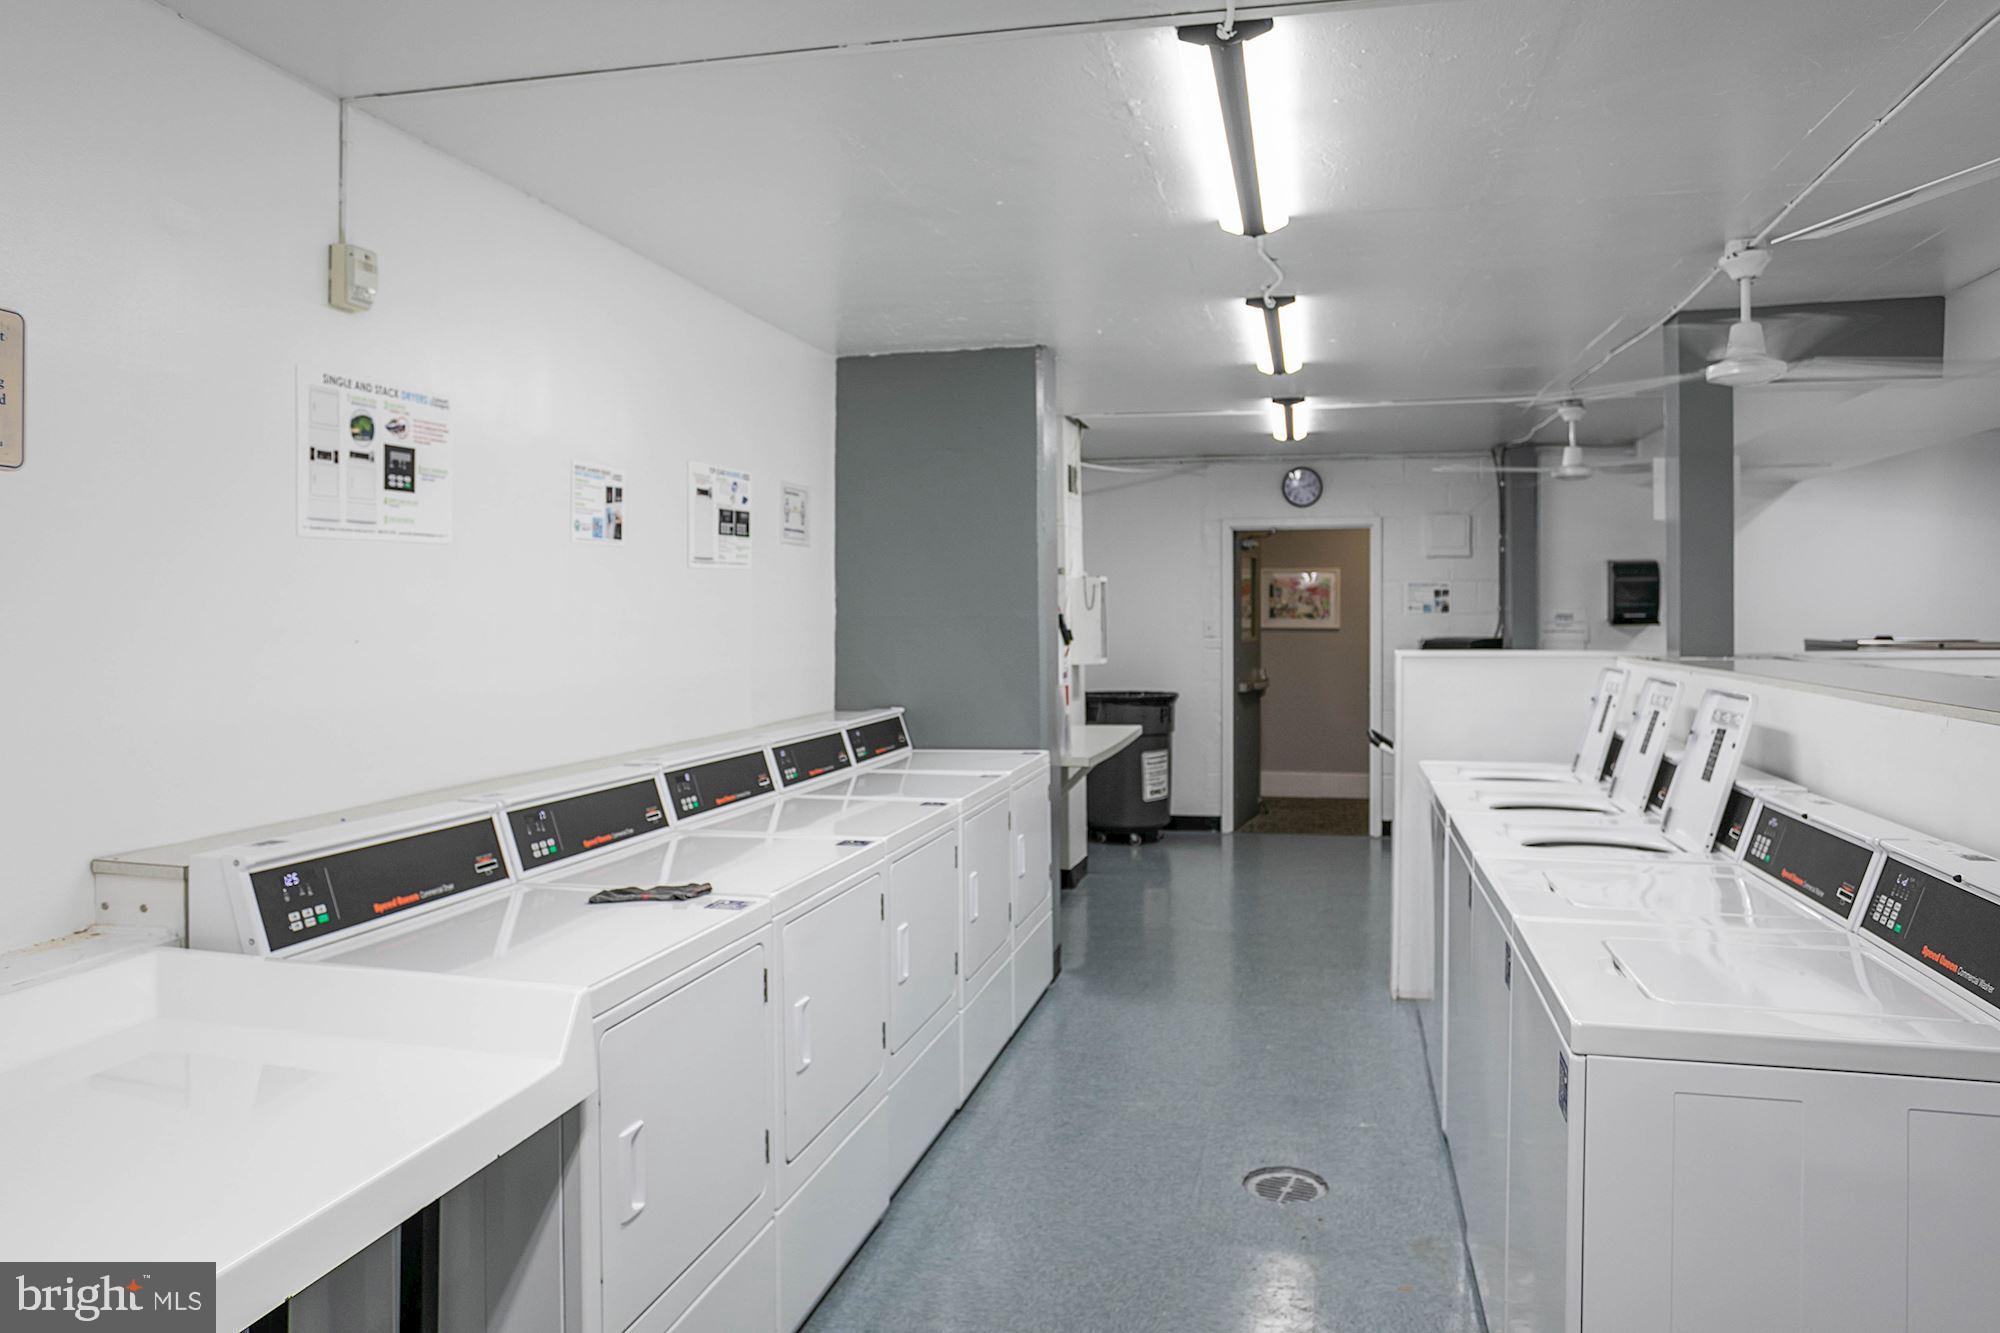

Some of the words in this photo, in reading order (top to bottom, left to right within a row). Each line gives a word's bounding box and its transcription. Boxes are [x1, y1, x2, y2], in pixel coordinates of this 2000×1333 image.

[322, 373, 352, 389] SINGLE
[355, 381, 372, 393] AND
[375, 385, 399, 399] STACK
[1921, 944, 1941, 963] Speed
[1939, 954, 1959, 974] Queen
[1957, 966, 1981, 986] Commercial
